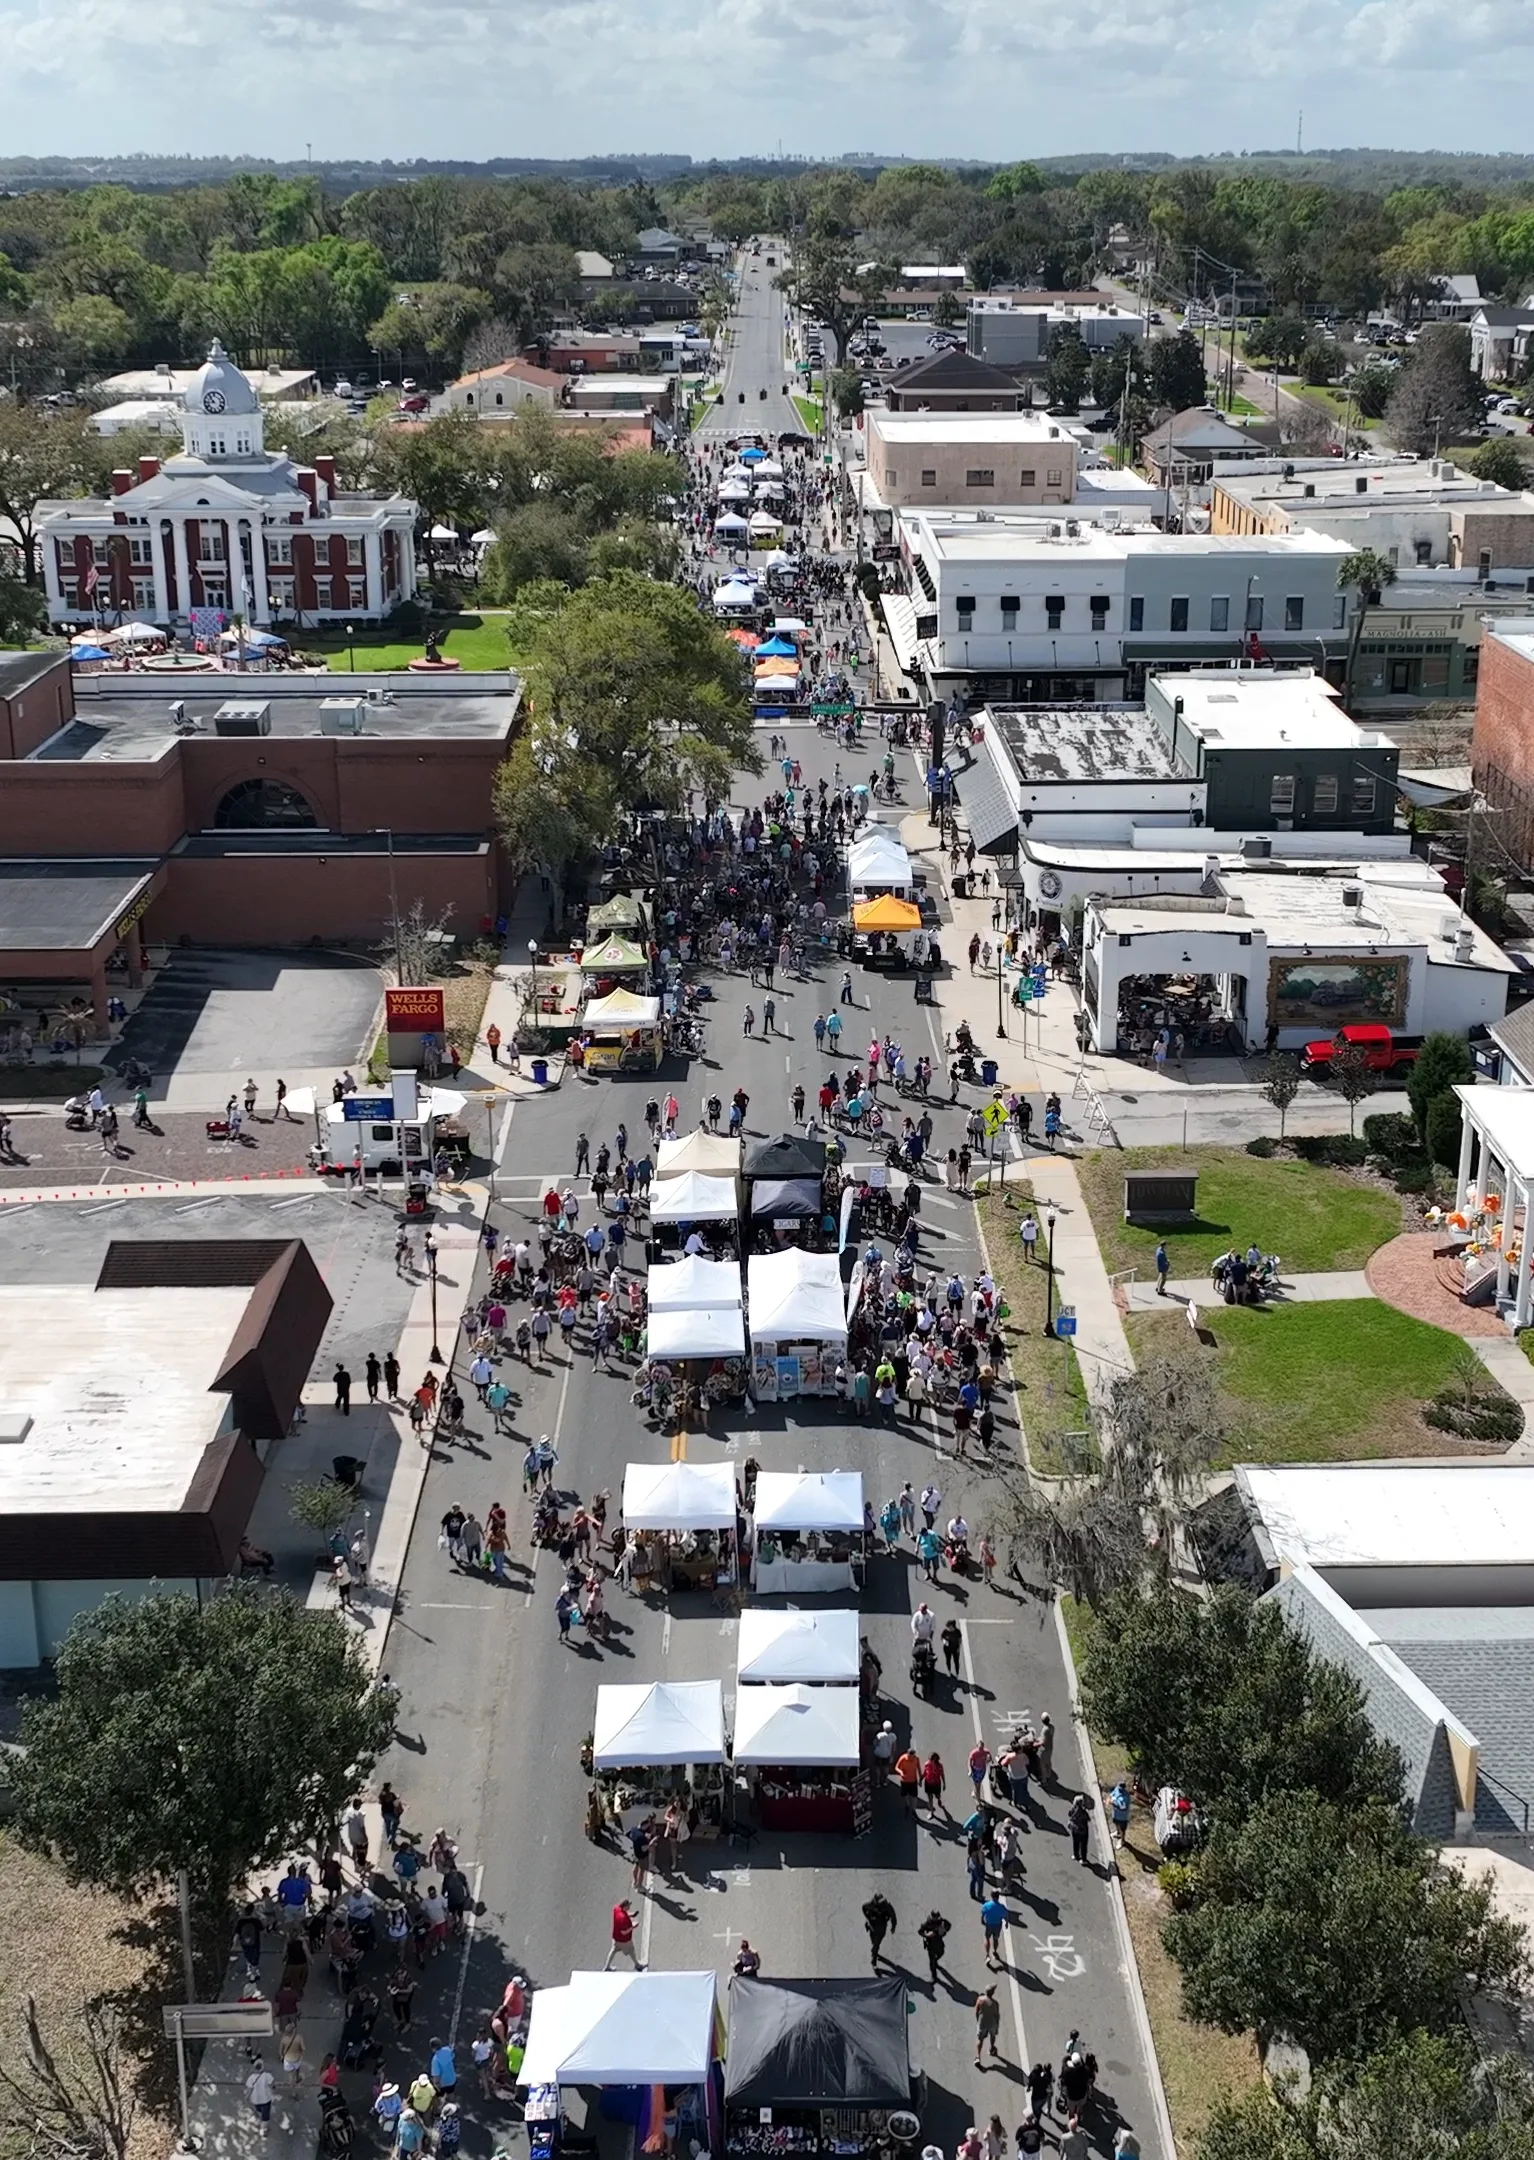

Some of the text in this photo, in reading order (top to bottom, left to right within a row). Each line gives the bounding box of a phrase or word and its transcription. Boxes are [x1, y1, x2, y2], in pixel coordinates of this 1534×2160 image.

[390, 994, 438, 1004] WELLS
[391, 1004, 438, 1014] FARGO
[774, 1220, 800, 1228] CIGARS
[1060, 1306, 1076, 1315] JCT
